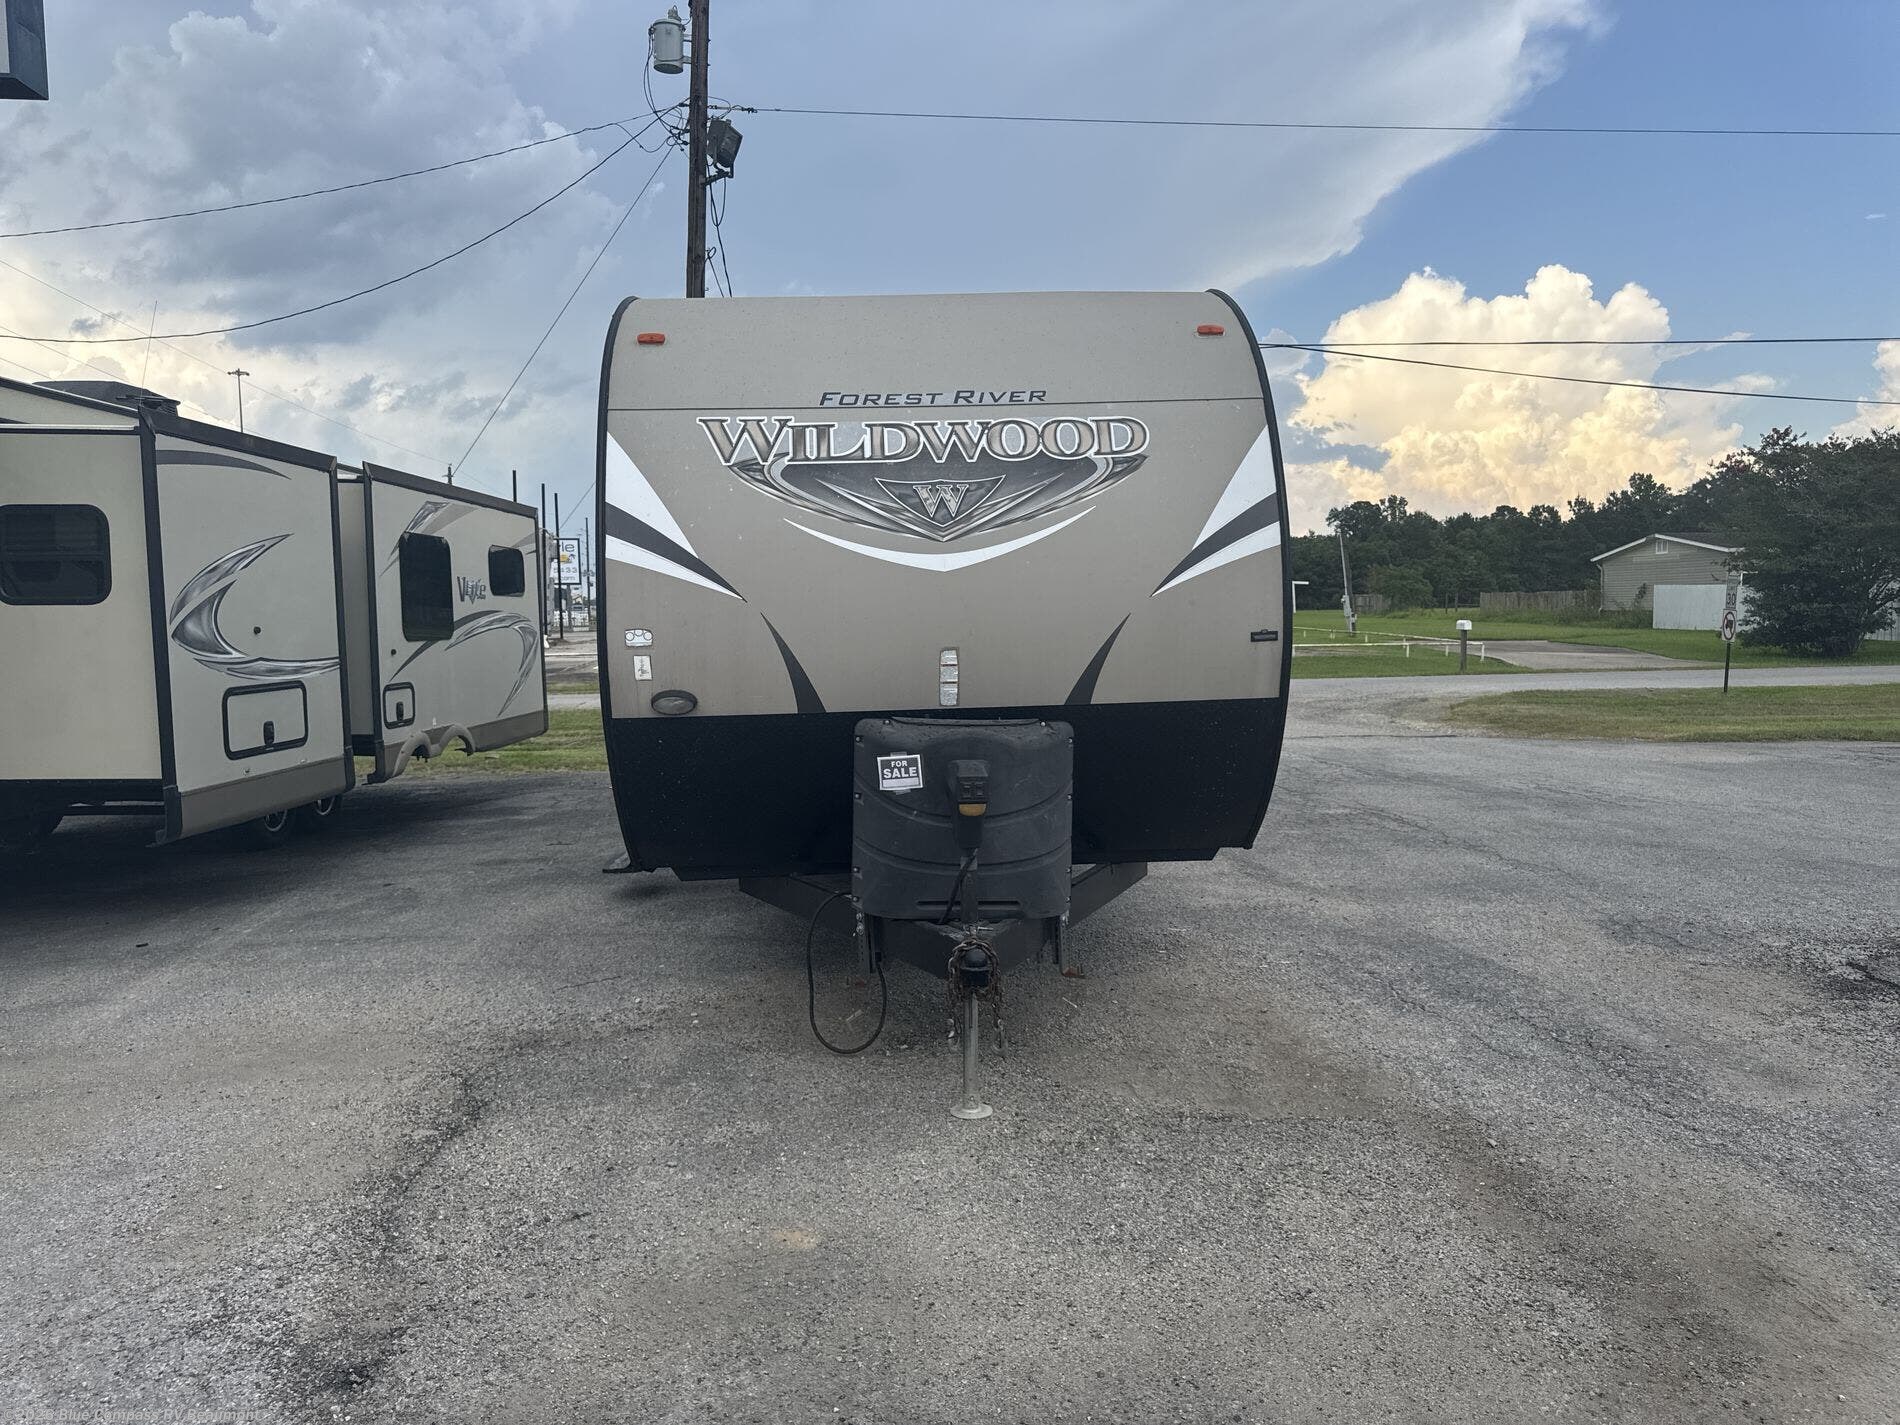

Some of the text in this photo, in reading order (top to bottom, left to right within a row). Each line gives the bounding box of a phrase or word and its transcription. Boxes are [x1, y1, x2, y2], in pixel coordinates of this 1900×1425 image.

[818, 389, 1048, 407] FOREST RIVER
[696, 416, 1150, 466] WILDWOOD
[912, 483, 968, 518] W
[883, 767, 918, 778] SALE
[891, 760, 908, 768] FOR
